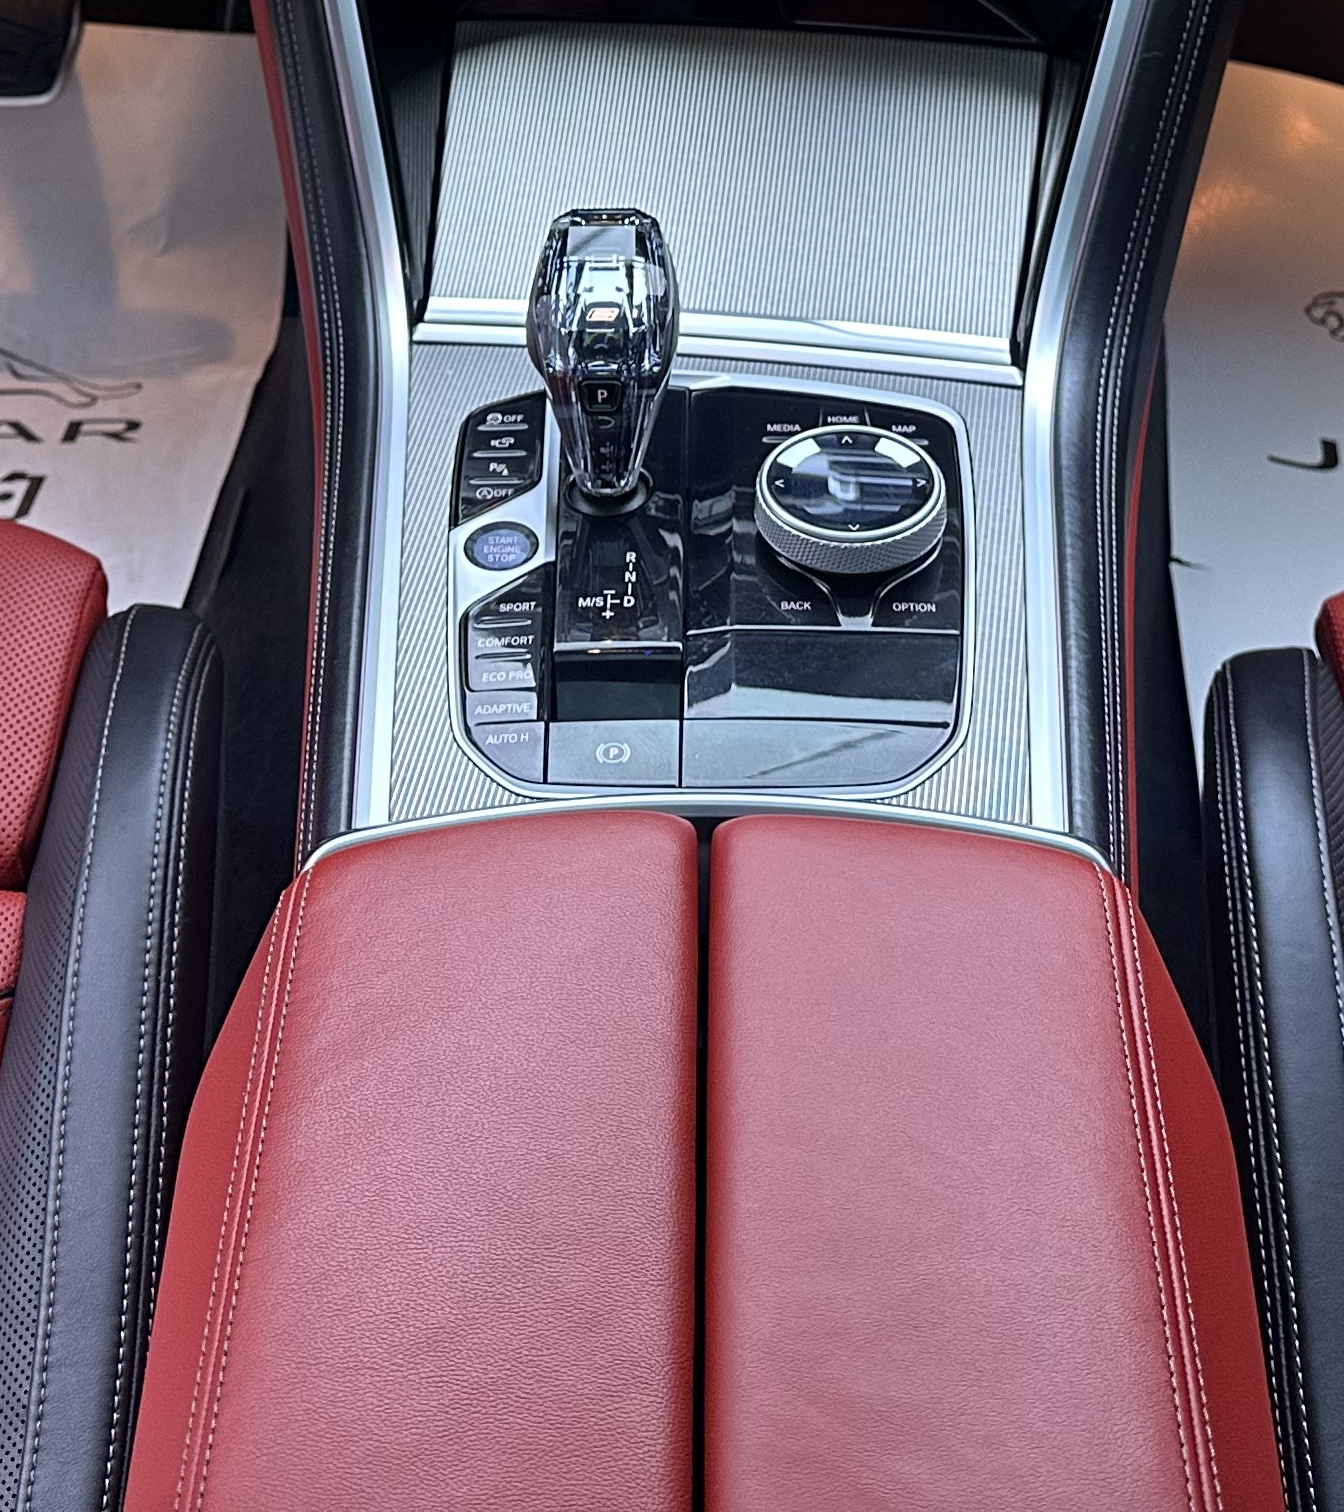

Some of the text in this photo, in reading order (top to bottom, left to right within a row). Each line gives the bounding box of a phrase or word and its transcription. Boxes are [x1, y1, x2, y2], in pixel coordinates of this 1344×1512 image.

[596, 390, 608, 404] P
[503, 414, 524, 423] OFF
[827, 415, 860, 424] HOME
[766, 424, 802, 432] MEDIA
[891, 425, 917, 433] MAP
[488, 536, 519, 545] START
[483, 545, 521, 554] ENGINE
[487, 554, 516, 563] STOP
[625, 551, 637, 563] R
[624, 571, 637, 583] N
[499, 601, 537, 613] SPORT
[577, 596, 605, 608] M/S
[623, 595, 635, 608] D
[780, 600, 812, 612] BACK
[892, 601, 937, 613] OPTION
[477, 634, 535, 648] COMFORT
[481, 668, 533, 683] ECO PRO
[474, 702, 532, 716] ADAPTIVE
[485, 732, 529, 746] AUTO H
